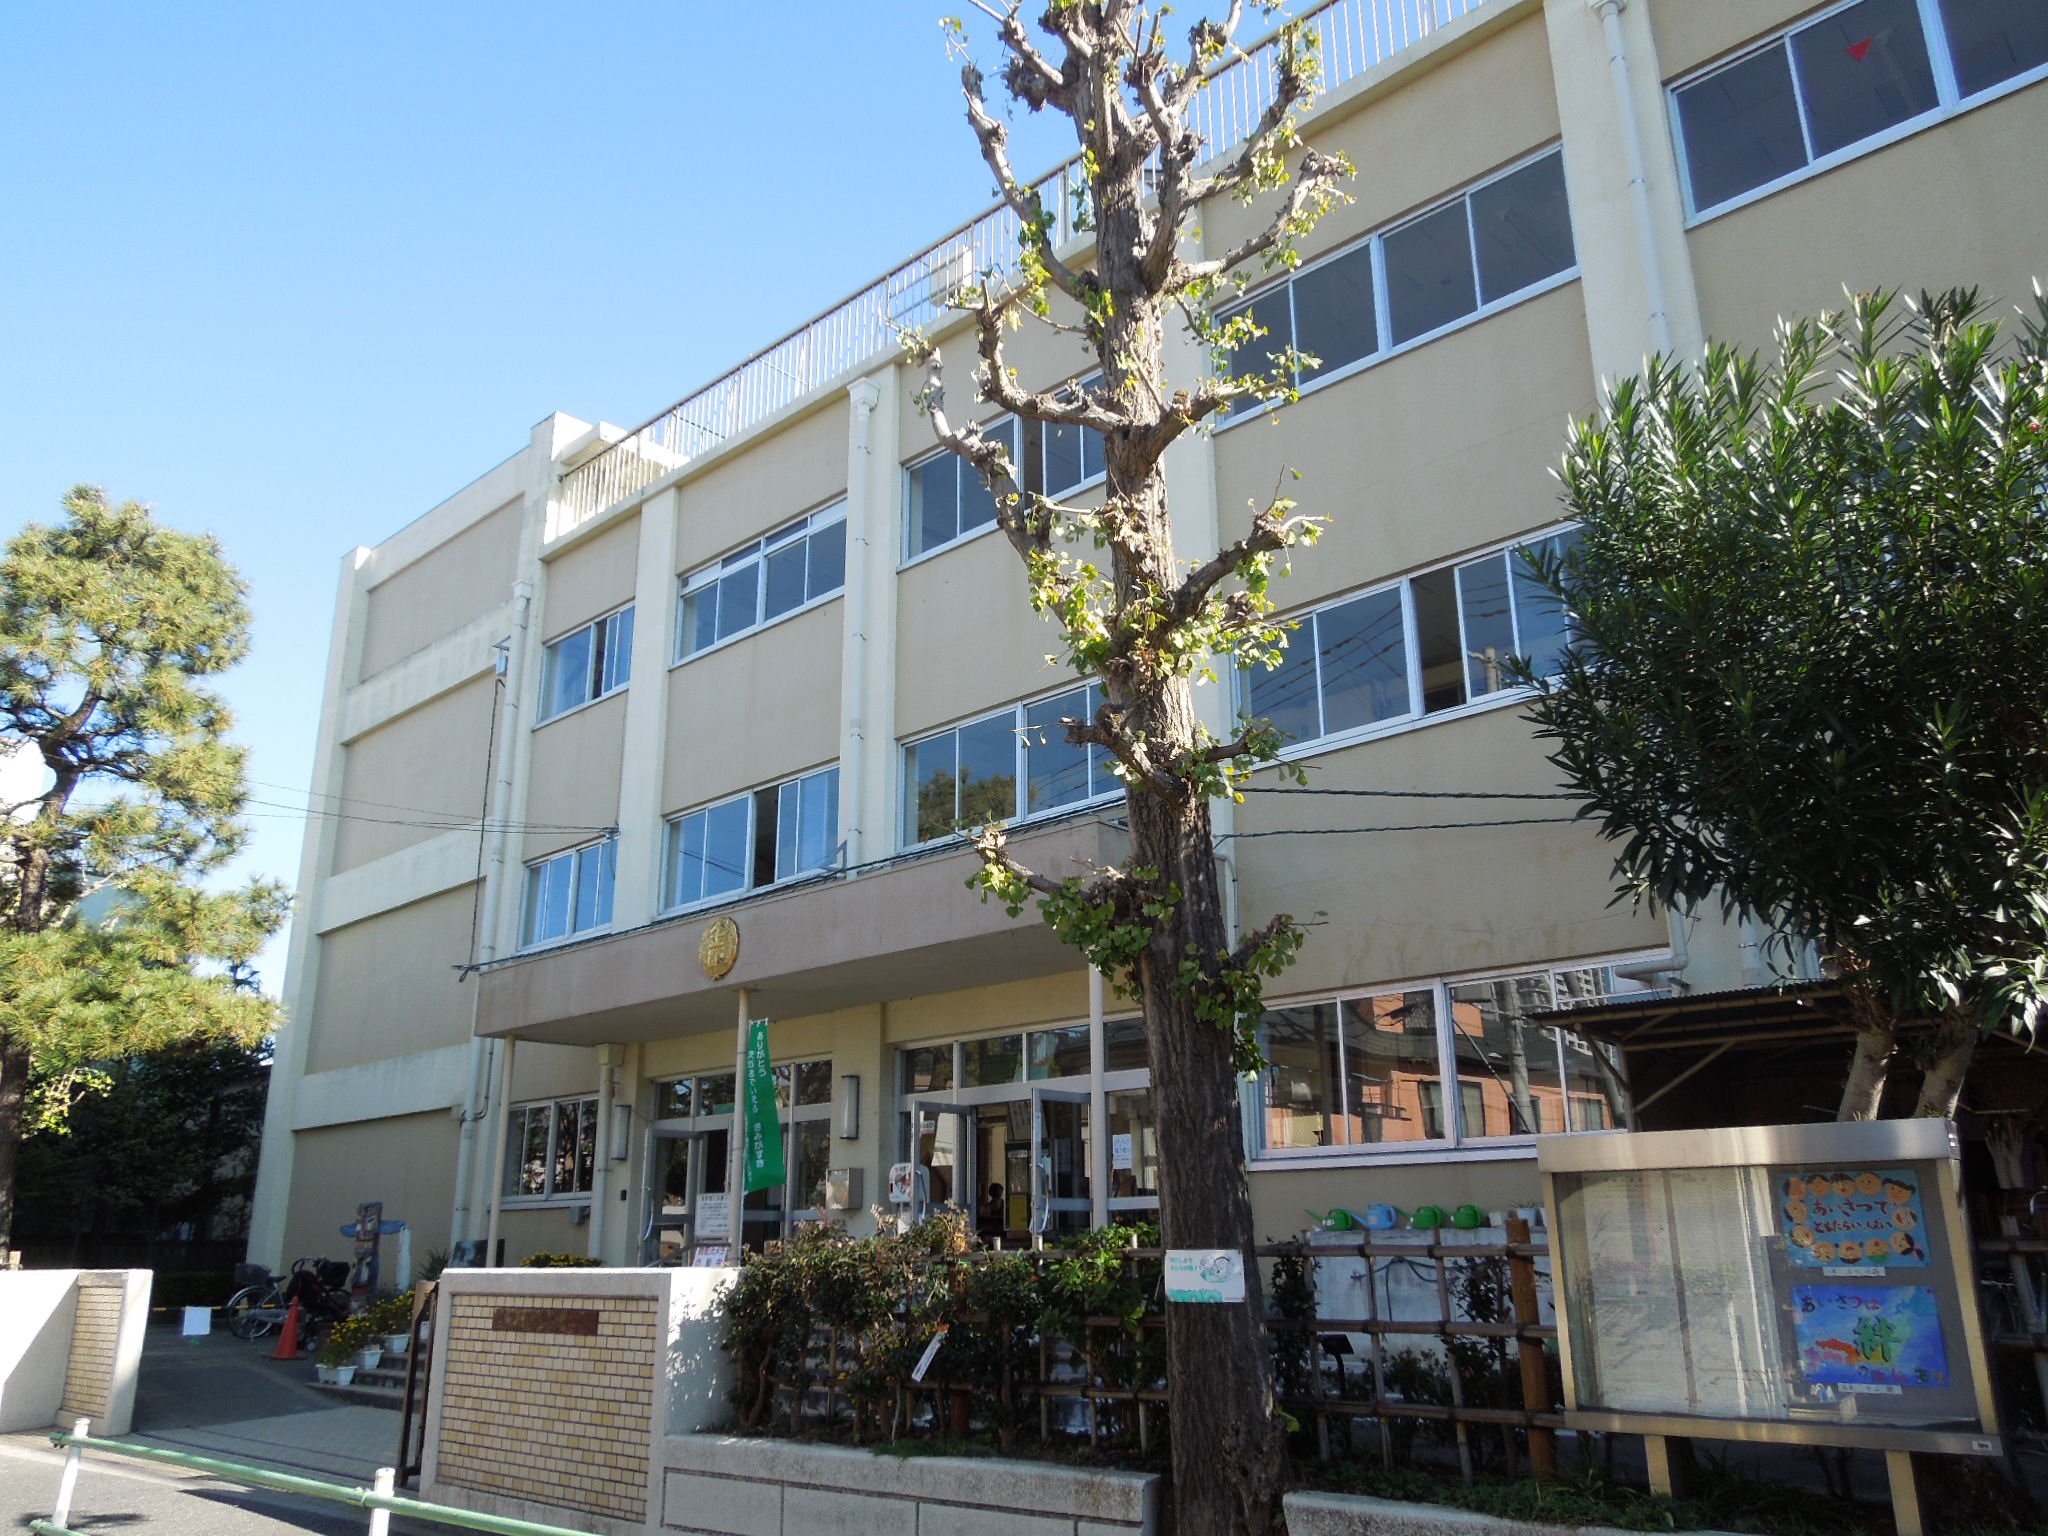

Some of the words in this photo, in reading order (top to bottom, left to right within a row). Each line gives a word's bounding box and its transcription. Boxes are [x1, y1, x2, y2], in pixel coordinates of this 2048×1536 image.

[756, 1031, 767, 1077] ありがとう
[1813, 1199, 1897, 1217] あいさつで
[1802, 1295, 1880, 1313] あいさつは
[1852, 1316, 1904, 1363] 絆
